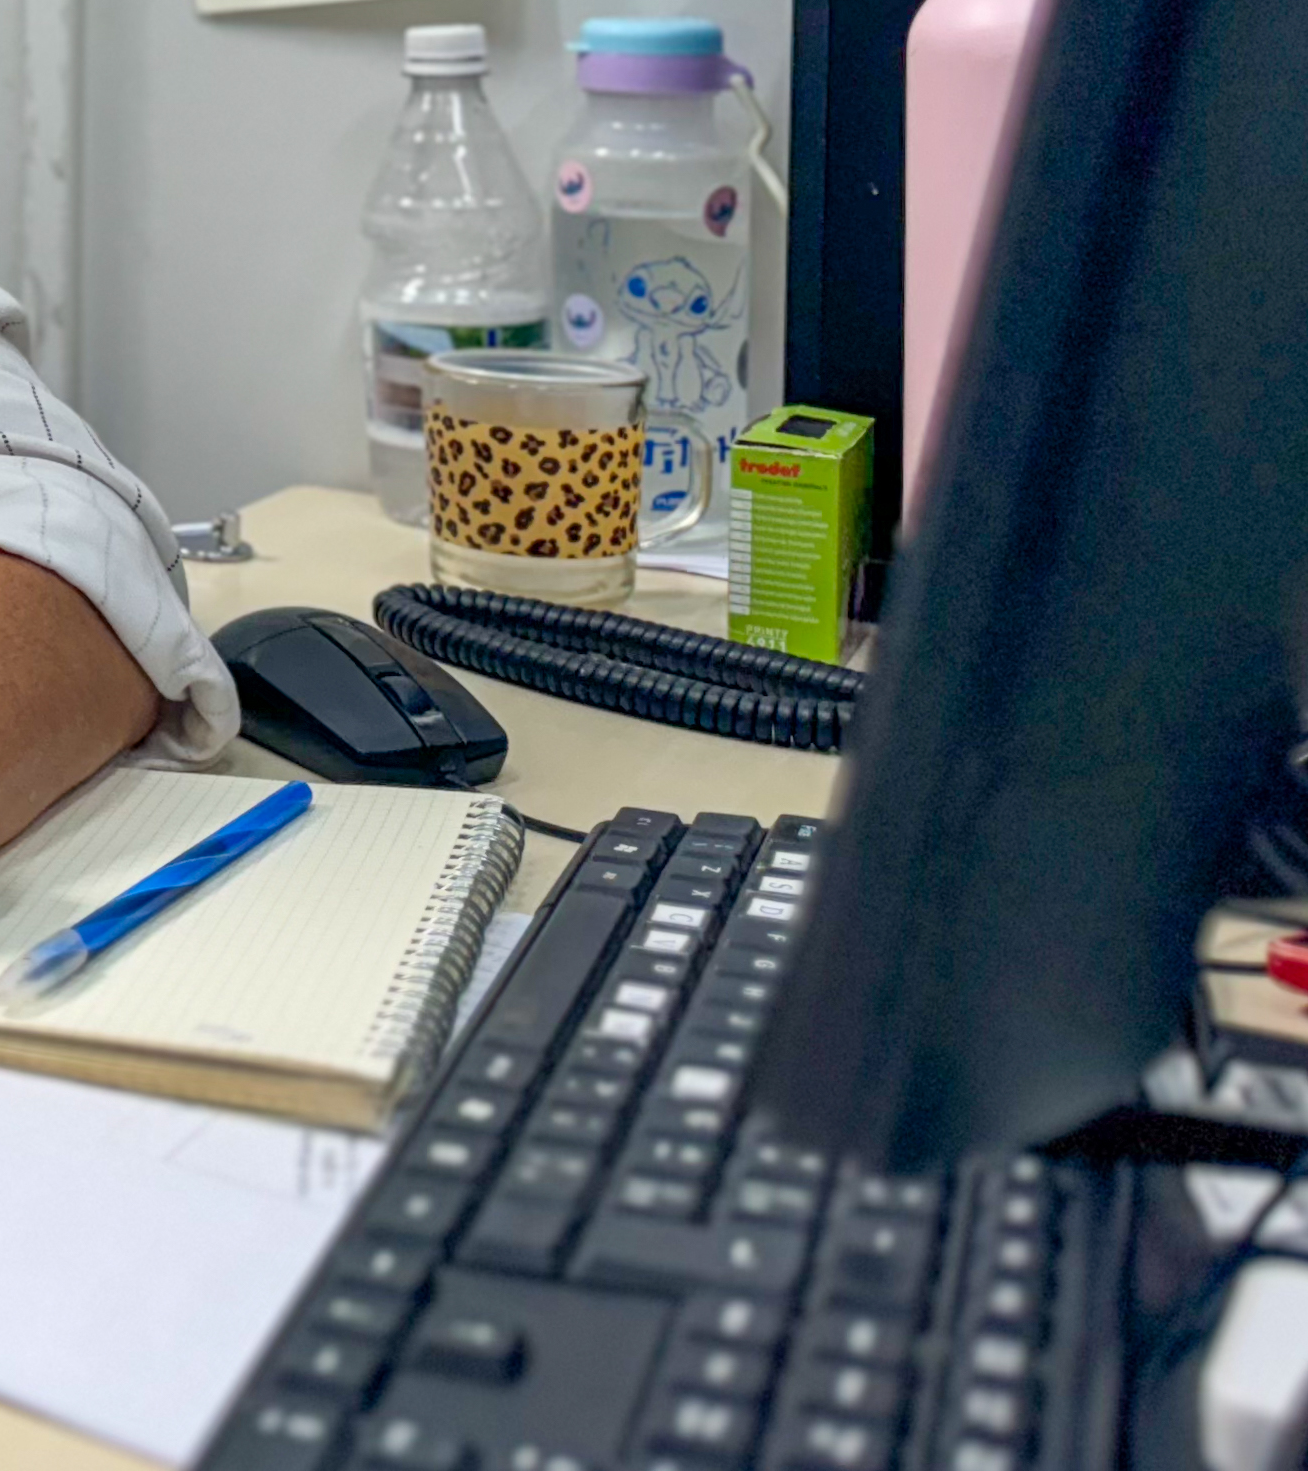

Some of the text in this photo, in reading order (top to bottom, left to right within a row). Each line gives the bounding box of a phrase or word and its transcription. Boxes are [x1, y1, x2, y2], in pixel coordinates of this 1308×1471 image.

[779, 857, 803, 865] A
[701, 865, 722, 874] Z
[768, 881, 793, 890] S
[691, 889, 712, 898] X
[759, 905, 784, 915] D
[668, 913, 694, 923] C
[754, 958, 776, 969] G
